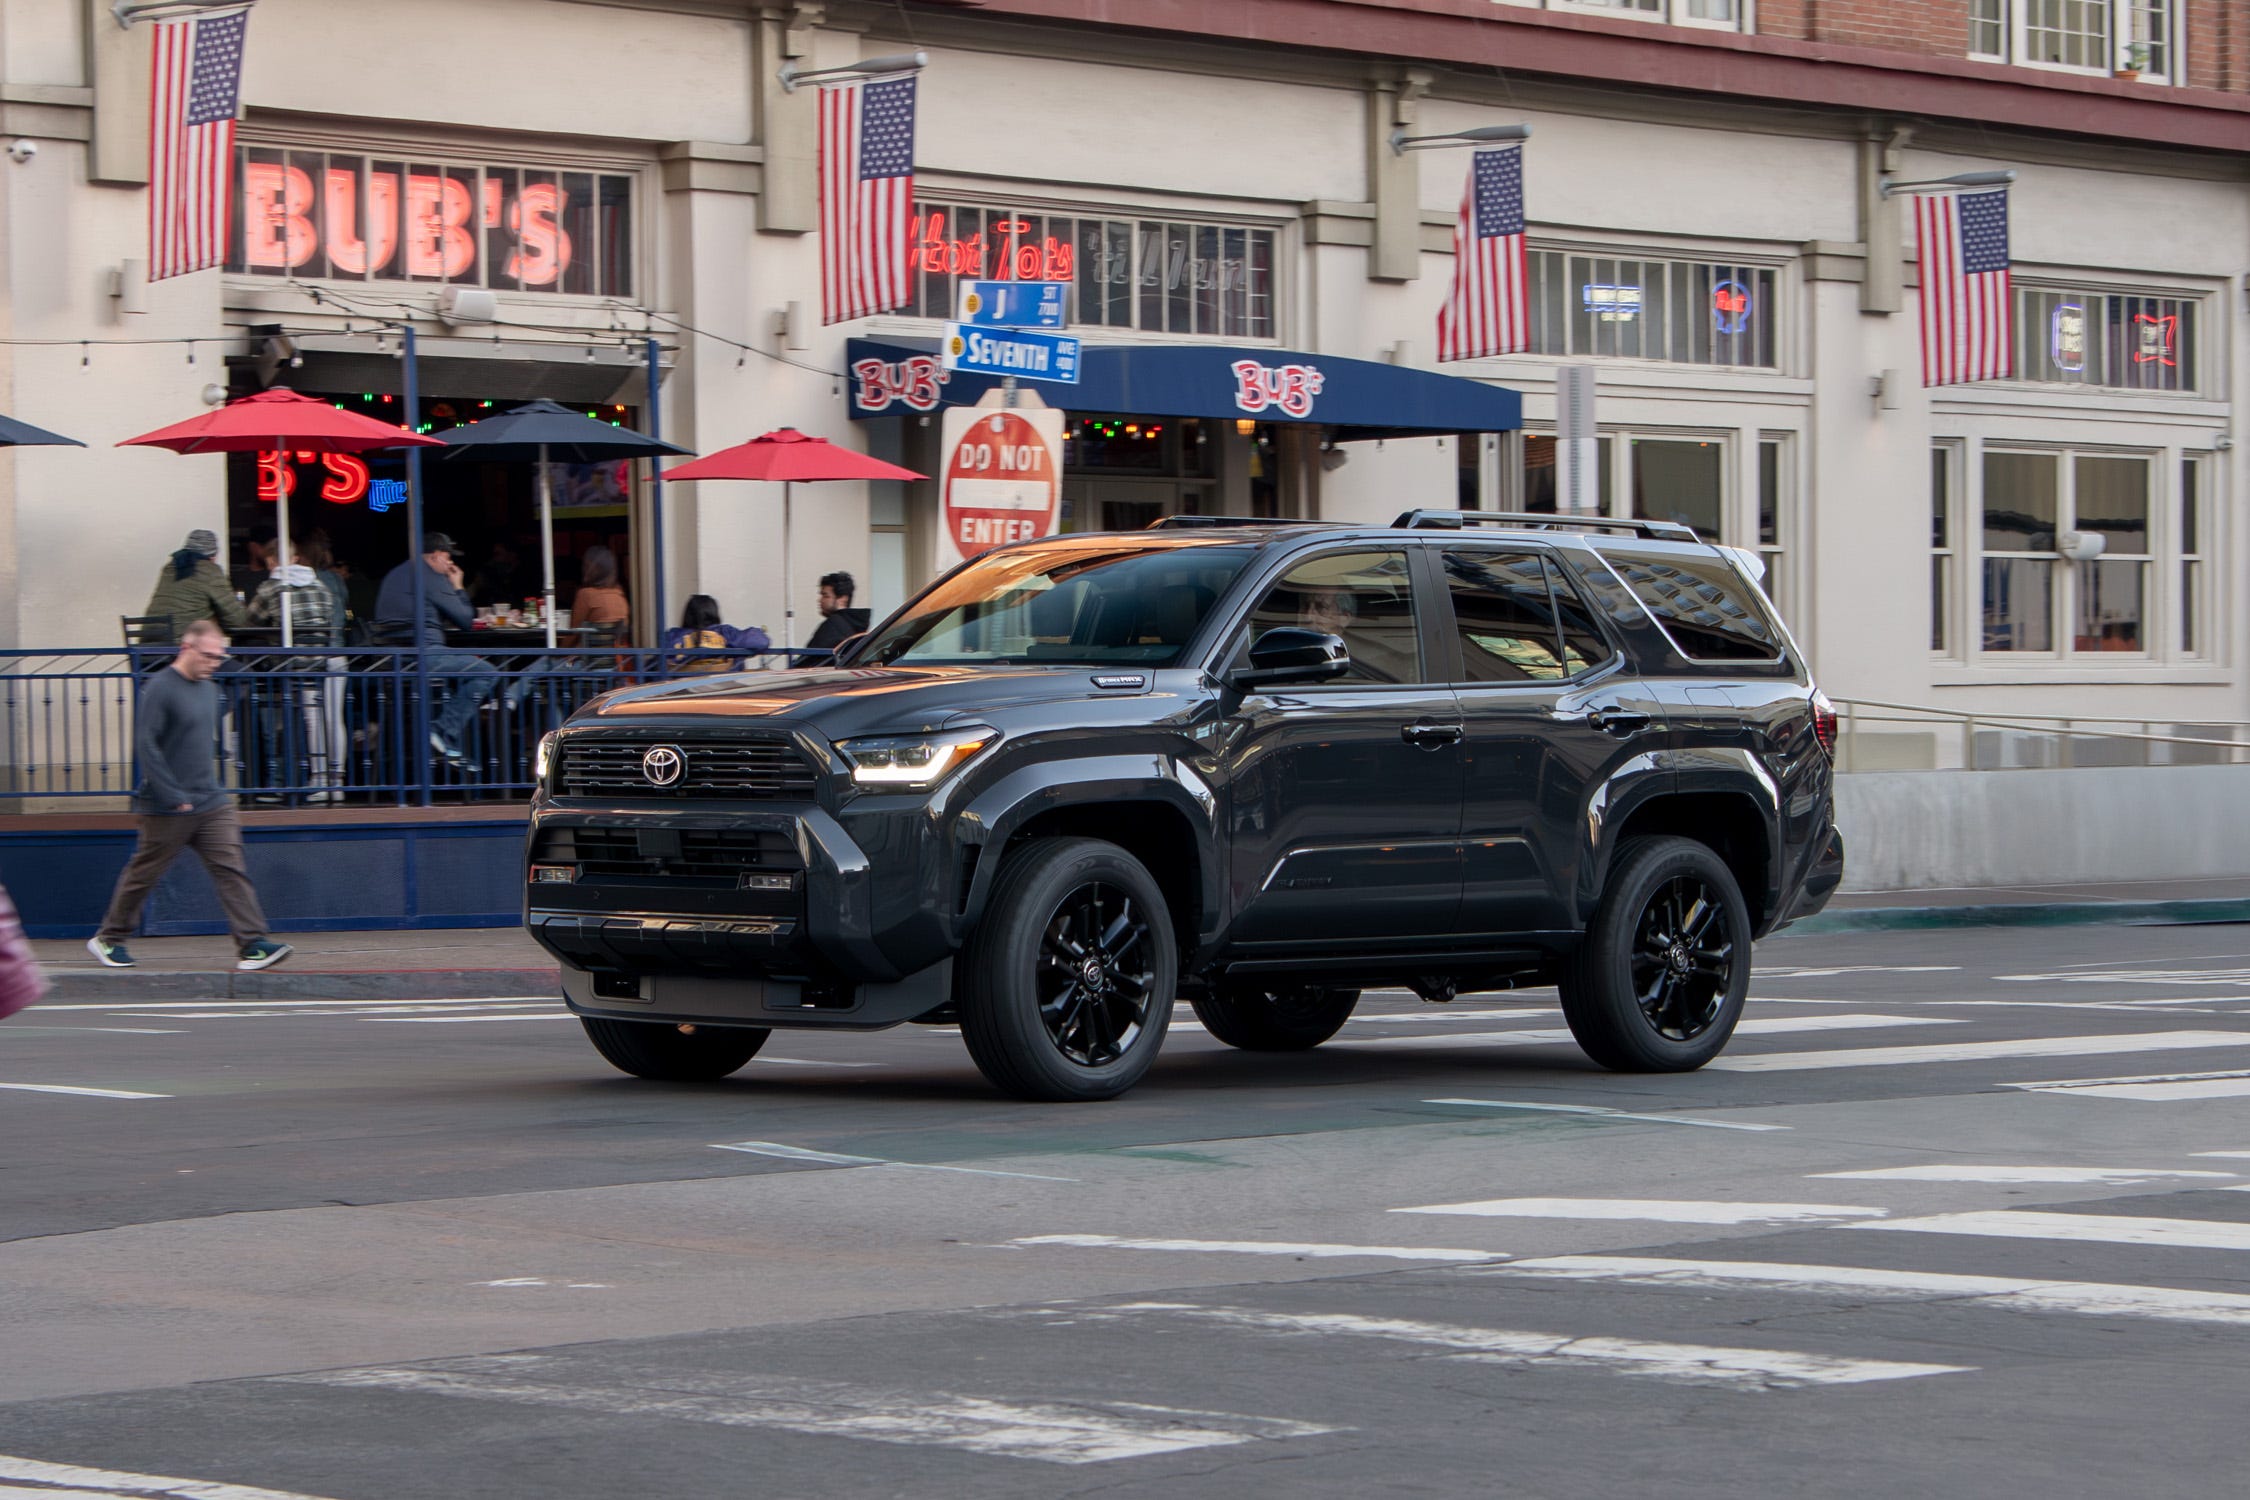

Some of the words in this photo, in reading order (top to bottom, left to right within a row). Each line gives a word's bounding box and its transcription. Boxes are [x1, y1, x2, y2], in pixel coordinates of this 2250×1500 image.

[247, 163, 572, 285] BUB'S
[992, 289, 1006, 319] J
[967, 332, 1049, 371] SEVENTH
[960, 443, 992, 471] DO
[1000, 445, 1045, 471] NOT
[960, 517, 1036, 544] ENTER
